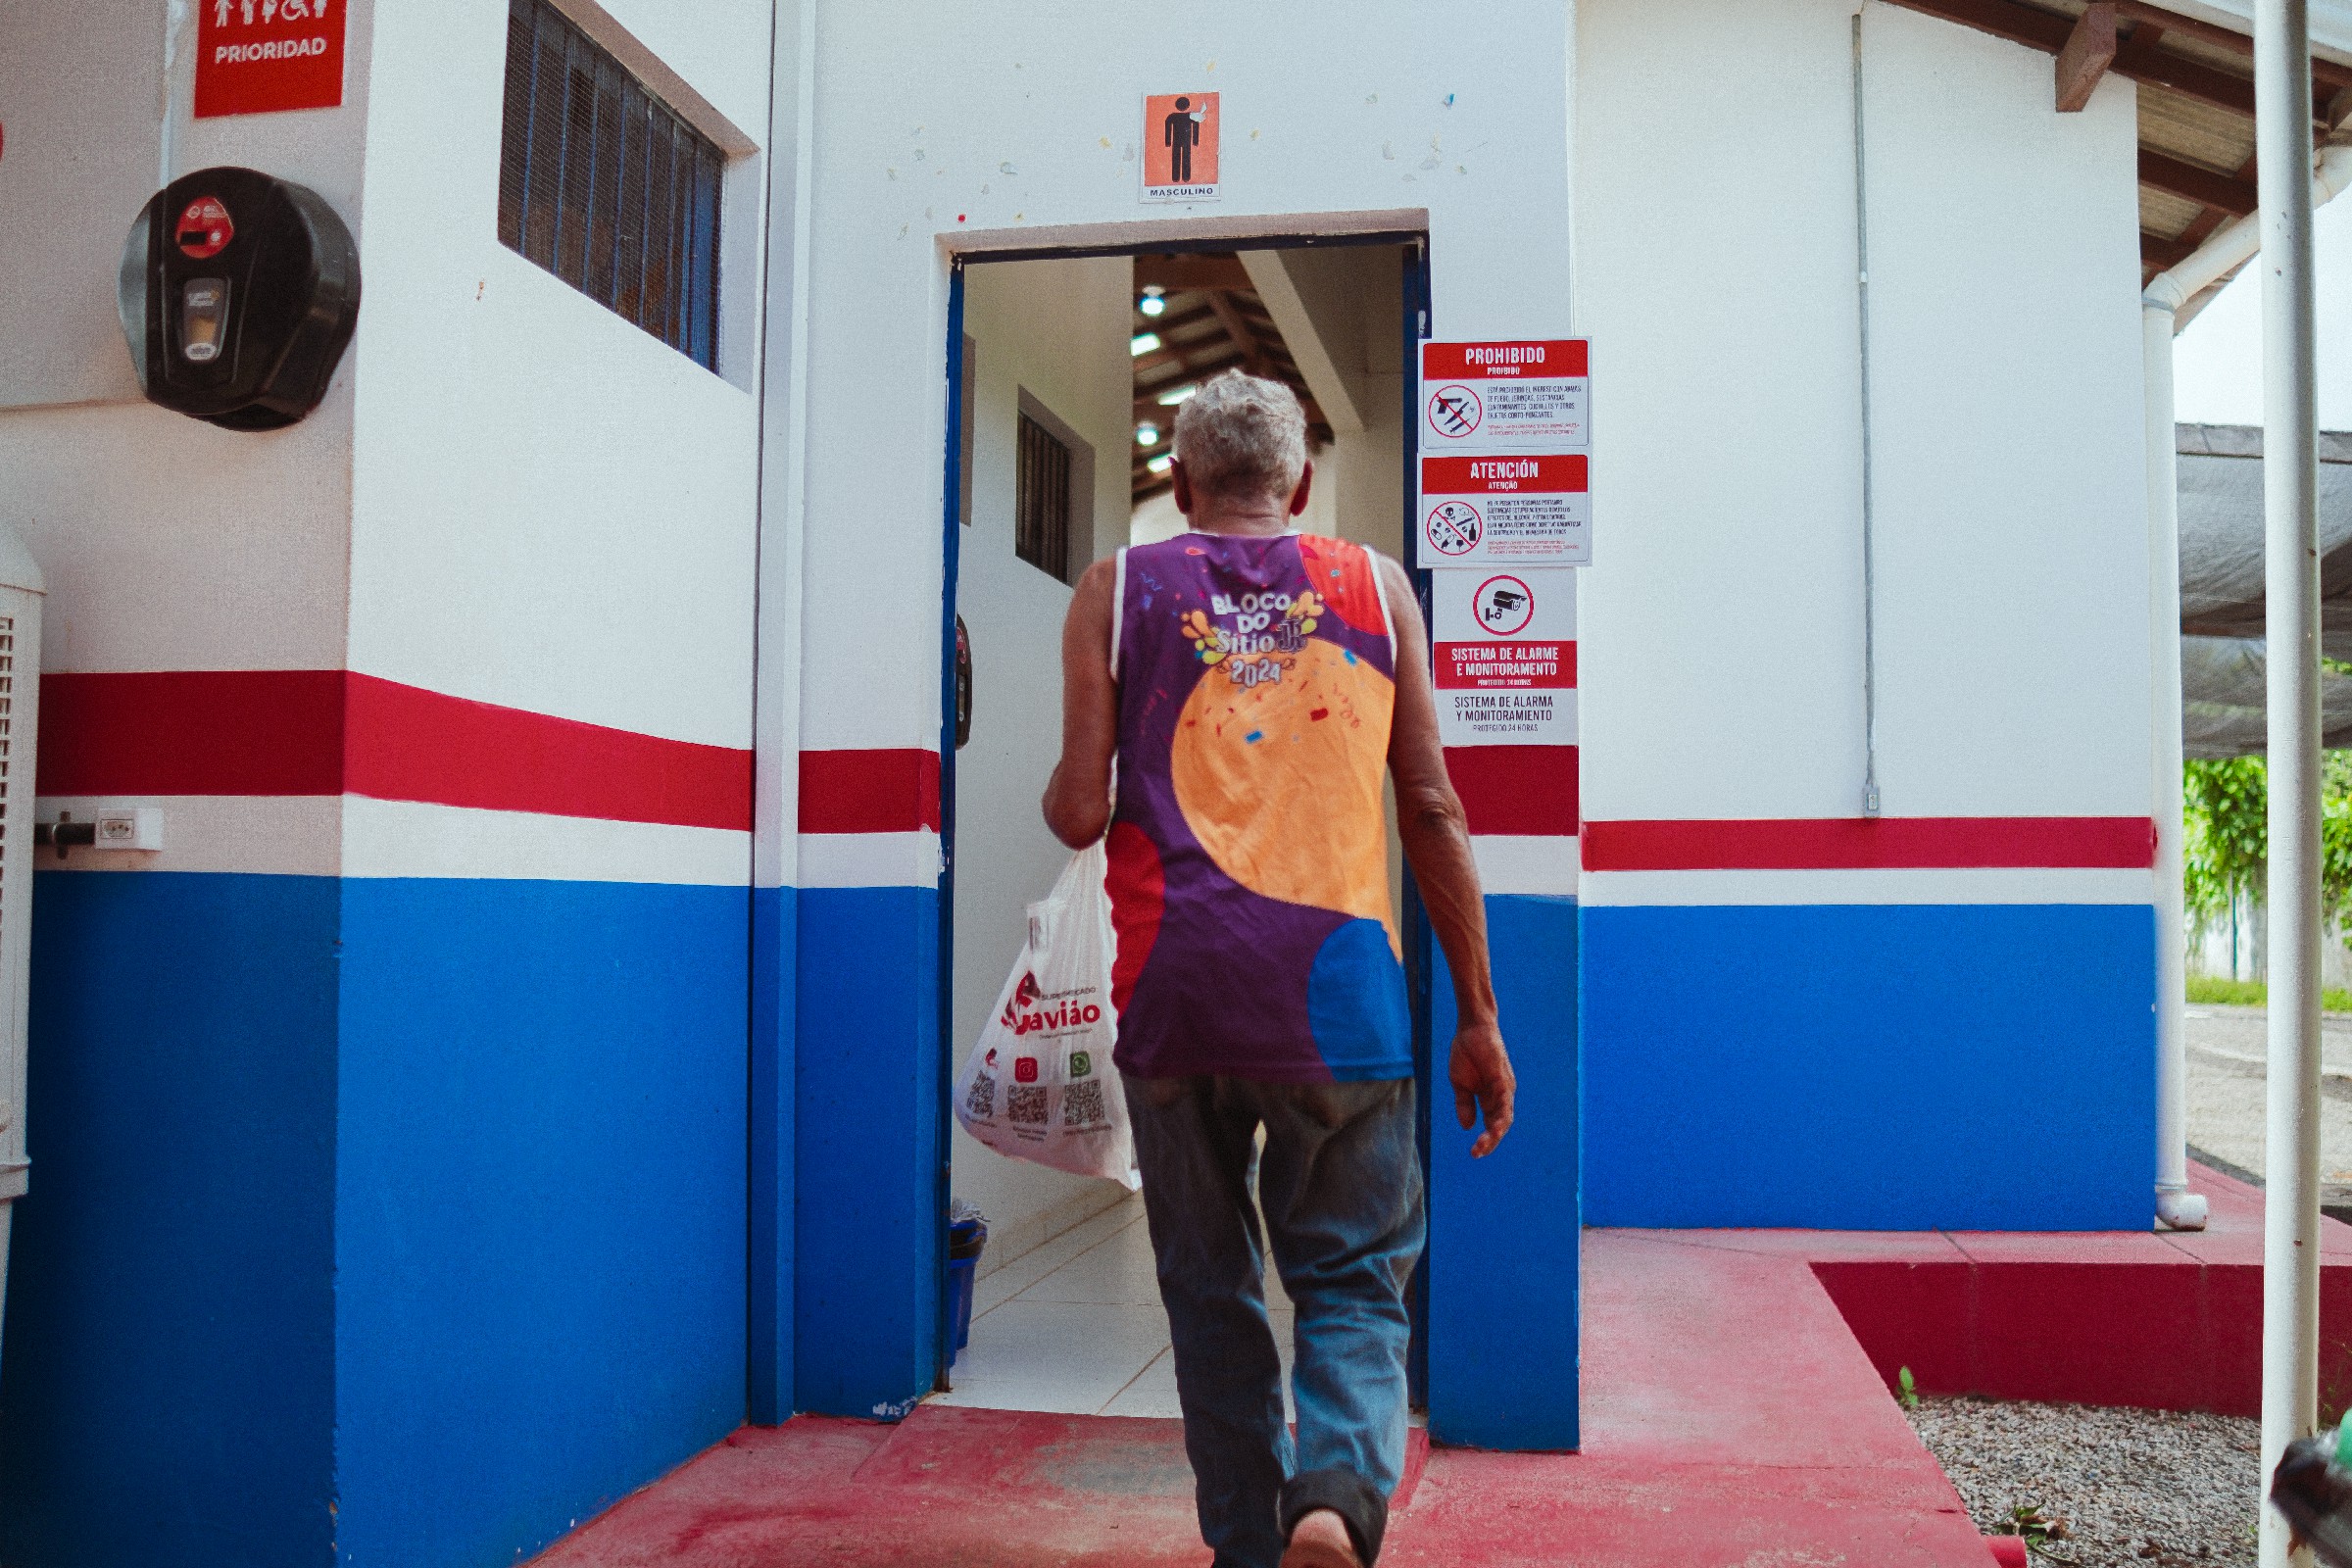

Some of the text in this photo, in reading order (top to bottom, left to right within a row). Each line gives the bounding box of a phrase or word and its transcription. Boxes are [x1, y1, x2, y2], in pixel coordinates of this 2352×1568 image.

[215, 37, 327, 64] PRIORIDAD
[1150, 187, 1213, 197] MASCULINO
[1465, 346, 1545, 366] PROHIBIDO
[1487, 367, 1521, 375] PROIBIDO
[1470, 459, 1539, 479] ATENCIÓN
[1488, 480, 1518, 492] ATENÇÃO
[1211, 592, 1291, 615] BLOCO
[1237, 612, 1271, 633] DO
[1451, 647, 1559, 662] SISTEMA DE ALARME
[1231, 659, 1281, 688] 2024
[1456, 662, 1557, 676] E MONITORAMENTO
[1454, 695, 1553, 709] SISTEMA DE ALARMA
[1456, 710, 1552, 721] Y MONITORAMIENTO
